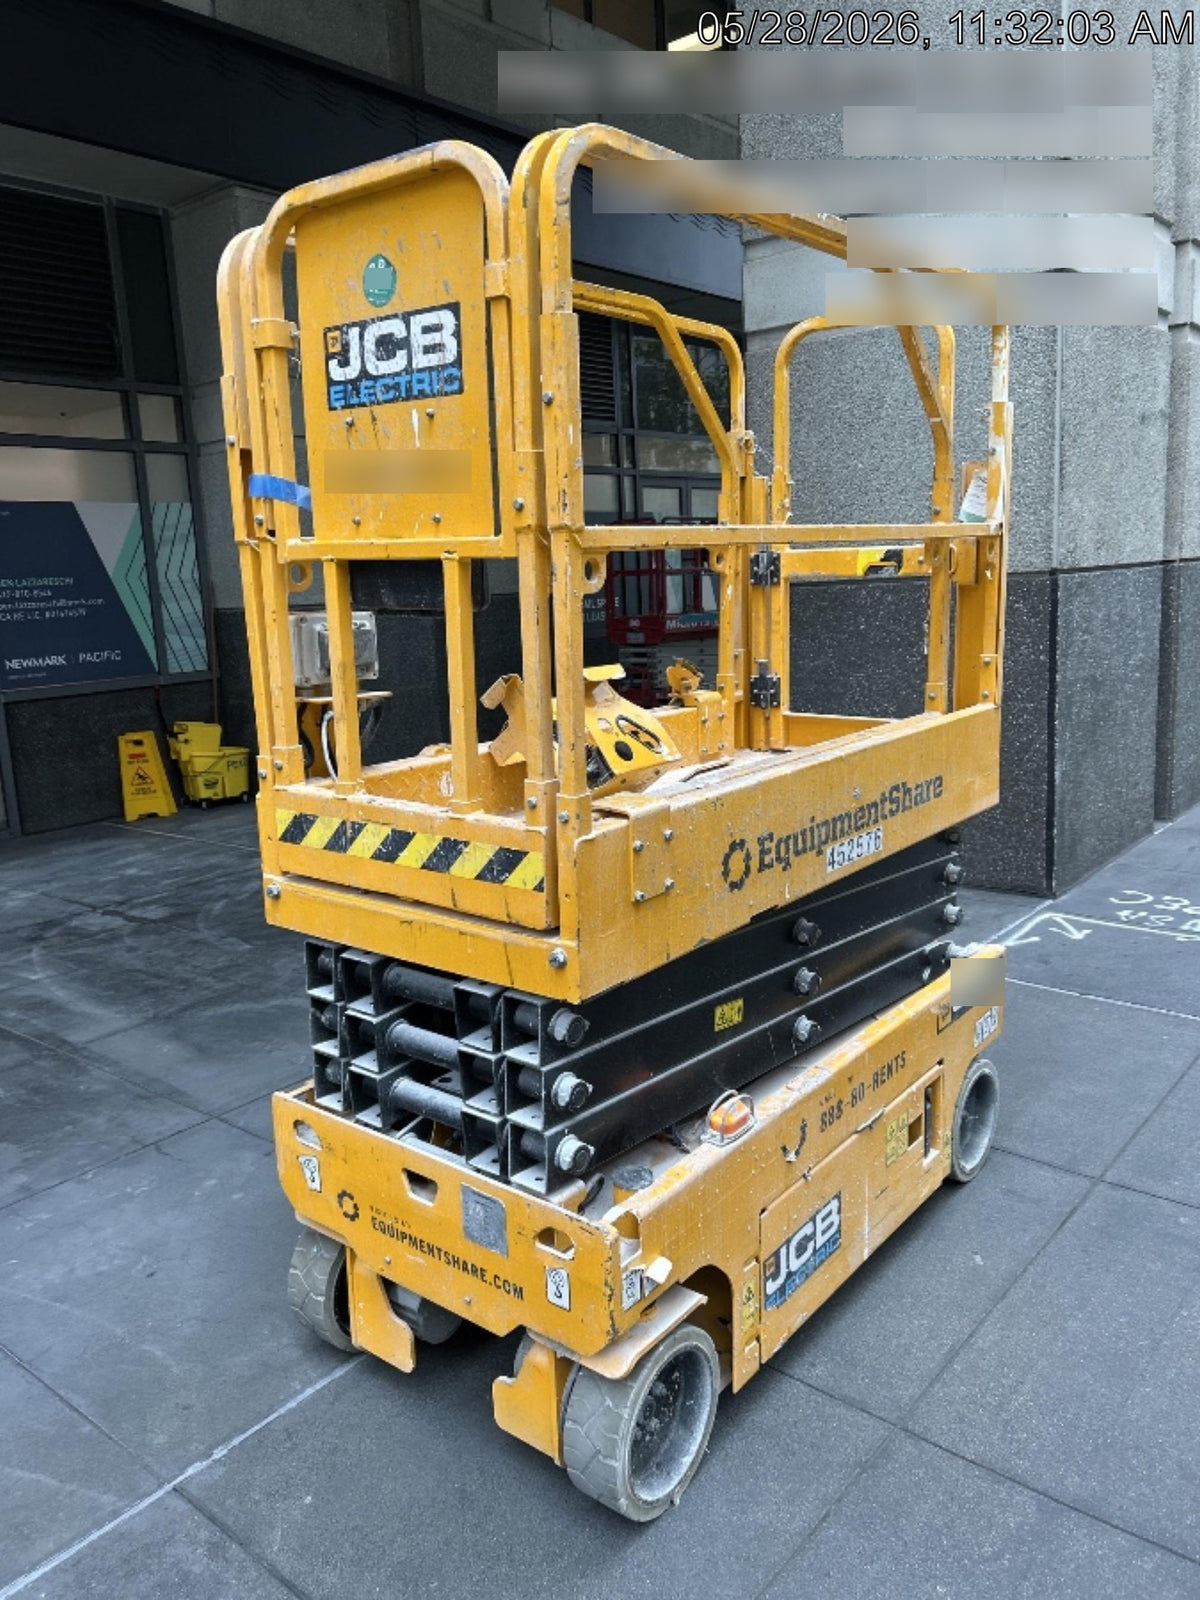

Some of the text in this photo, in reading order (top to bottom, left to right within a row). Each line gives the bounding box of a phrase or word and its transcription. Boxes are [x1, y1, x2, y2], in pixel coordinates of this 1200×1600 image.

[328, 309, 458, 381] JCB
[328, 367, 462, 409] ELECTRIC
[4, 650, 122, 670] NEWMARK PACIFIC
[757, 775, 943, 873] EquipmentShare
[820, 1050, 906, 1133] 888-80-RENTS
[370, 1215, 525, 1301] EQUIPMENTSHARE.COM
[765, 1197, 840, 1295] JCB
